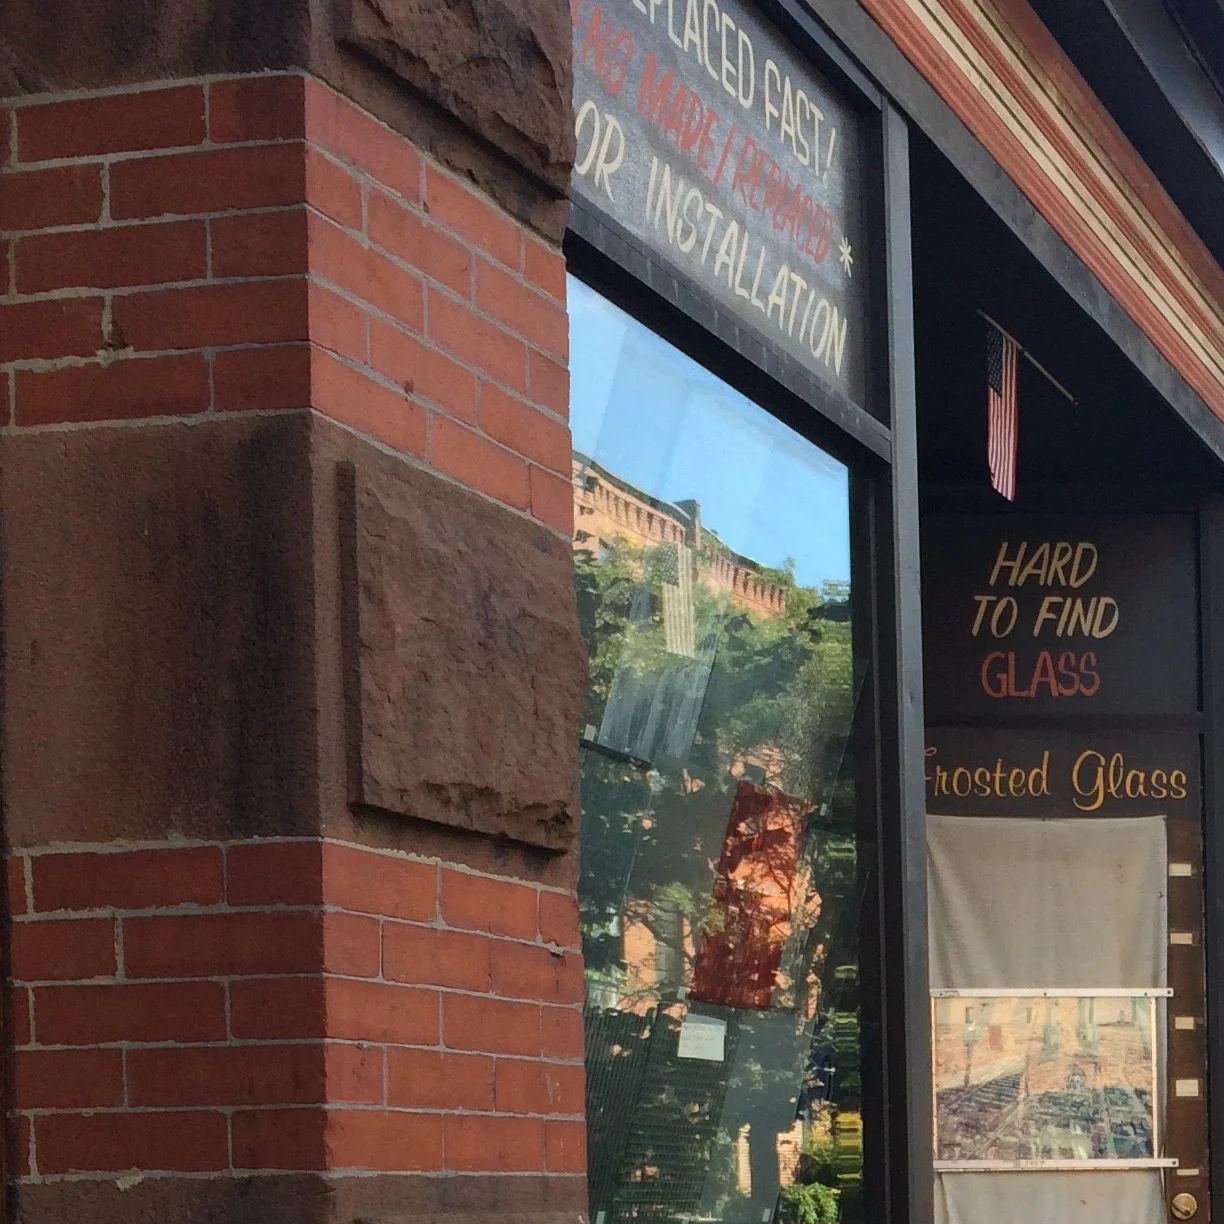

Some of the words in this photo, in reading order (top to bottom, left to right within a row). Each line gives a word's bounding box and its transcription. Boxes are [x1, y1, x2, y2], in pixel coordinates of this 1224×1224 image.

[632, 0, 755, 109] LACED
[764, 59, 837, 188] FAST!
[645, 156, 848, 376] INSTALLATION
[988, 541, 1099, 589] HARD
[971, 595, 1019, 638] TO
[1033, 597, 1120, 639] FIND
[981, 651, 1101, 698] GLASS
[1072, 749, 1188, 811] Glass
